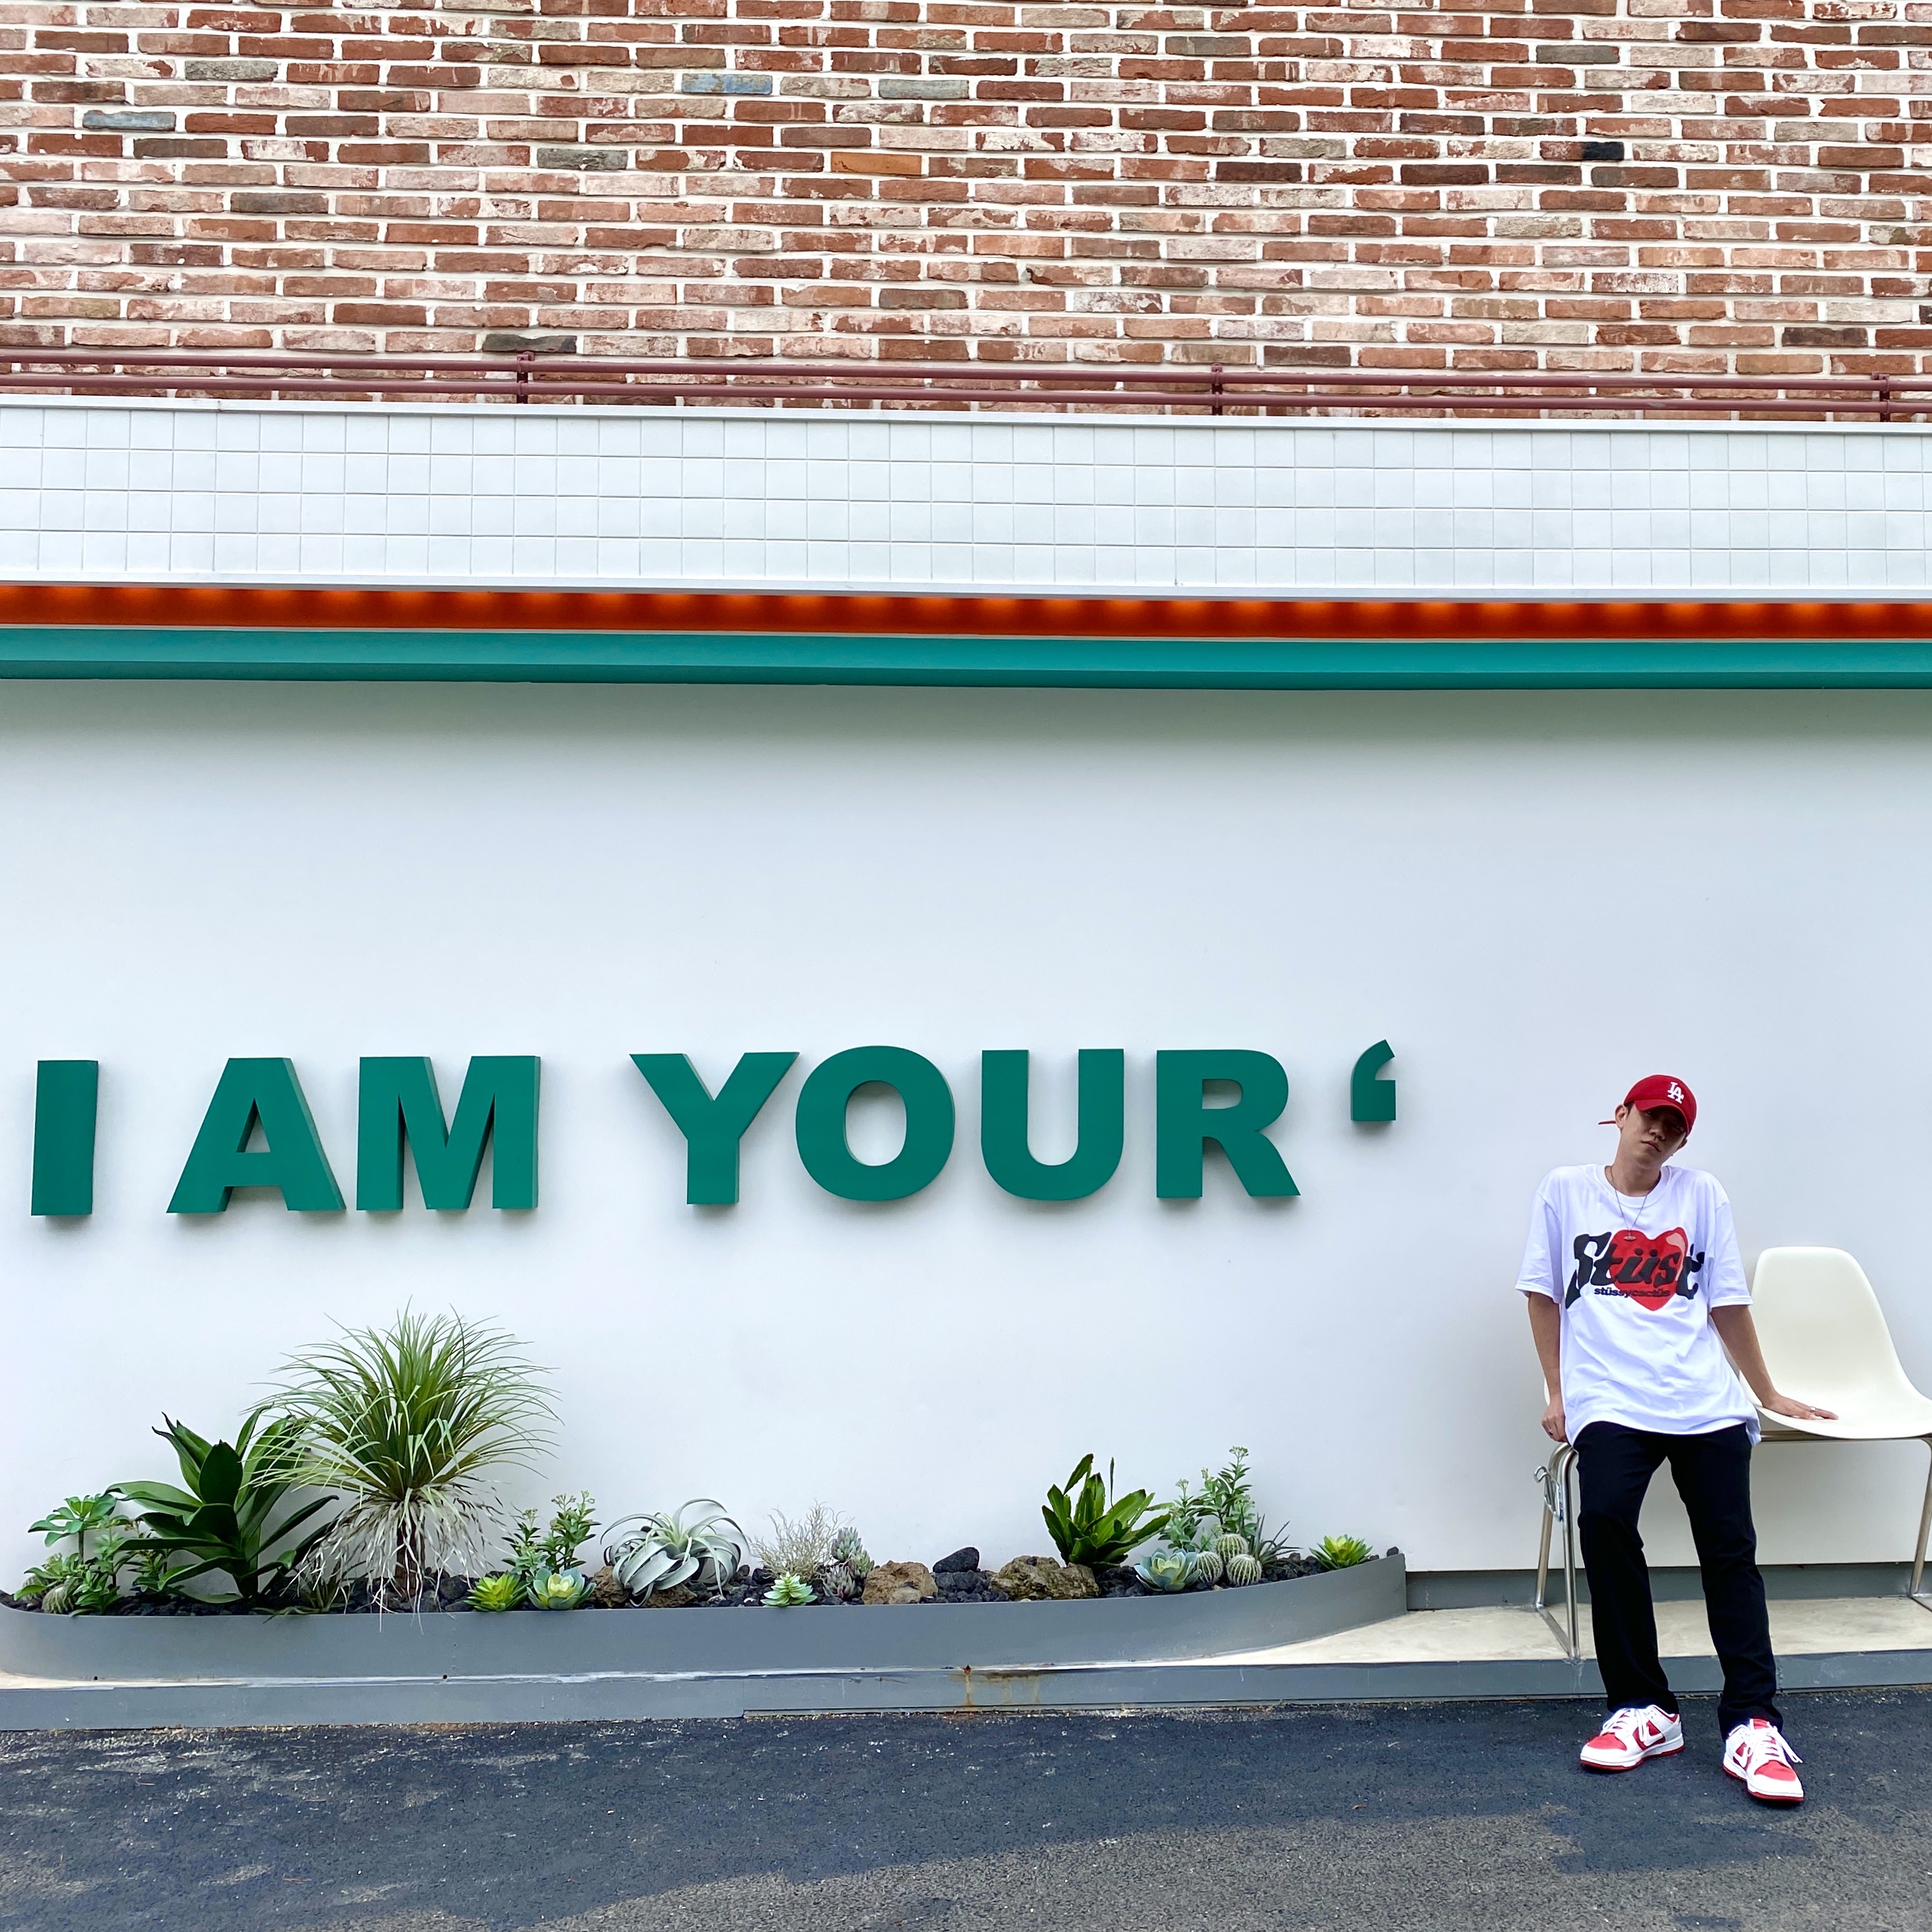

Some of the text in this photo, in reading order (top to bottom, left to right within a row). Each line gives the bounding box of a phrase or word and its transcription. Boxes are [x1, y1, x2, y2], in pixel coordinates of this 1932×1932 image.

[31, 1059, 98, 1217] I
[166, 1056, 540, 1215] AM
[629, 1045, 1301, 1206] YOUR
[1667, 1081, 1685, 1104] LA
